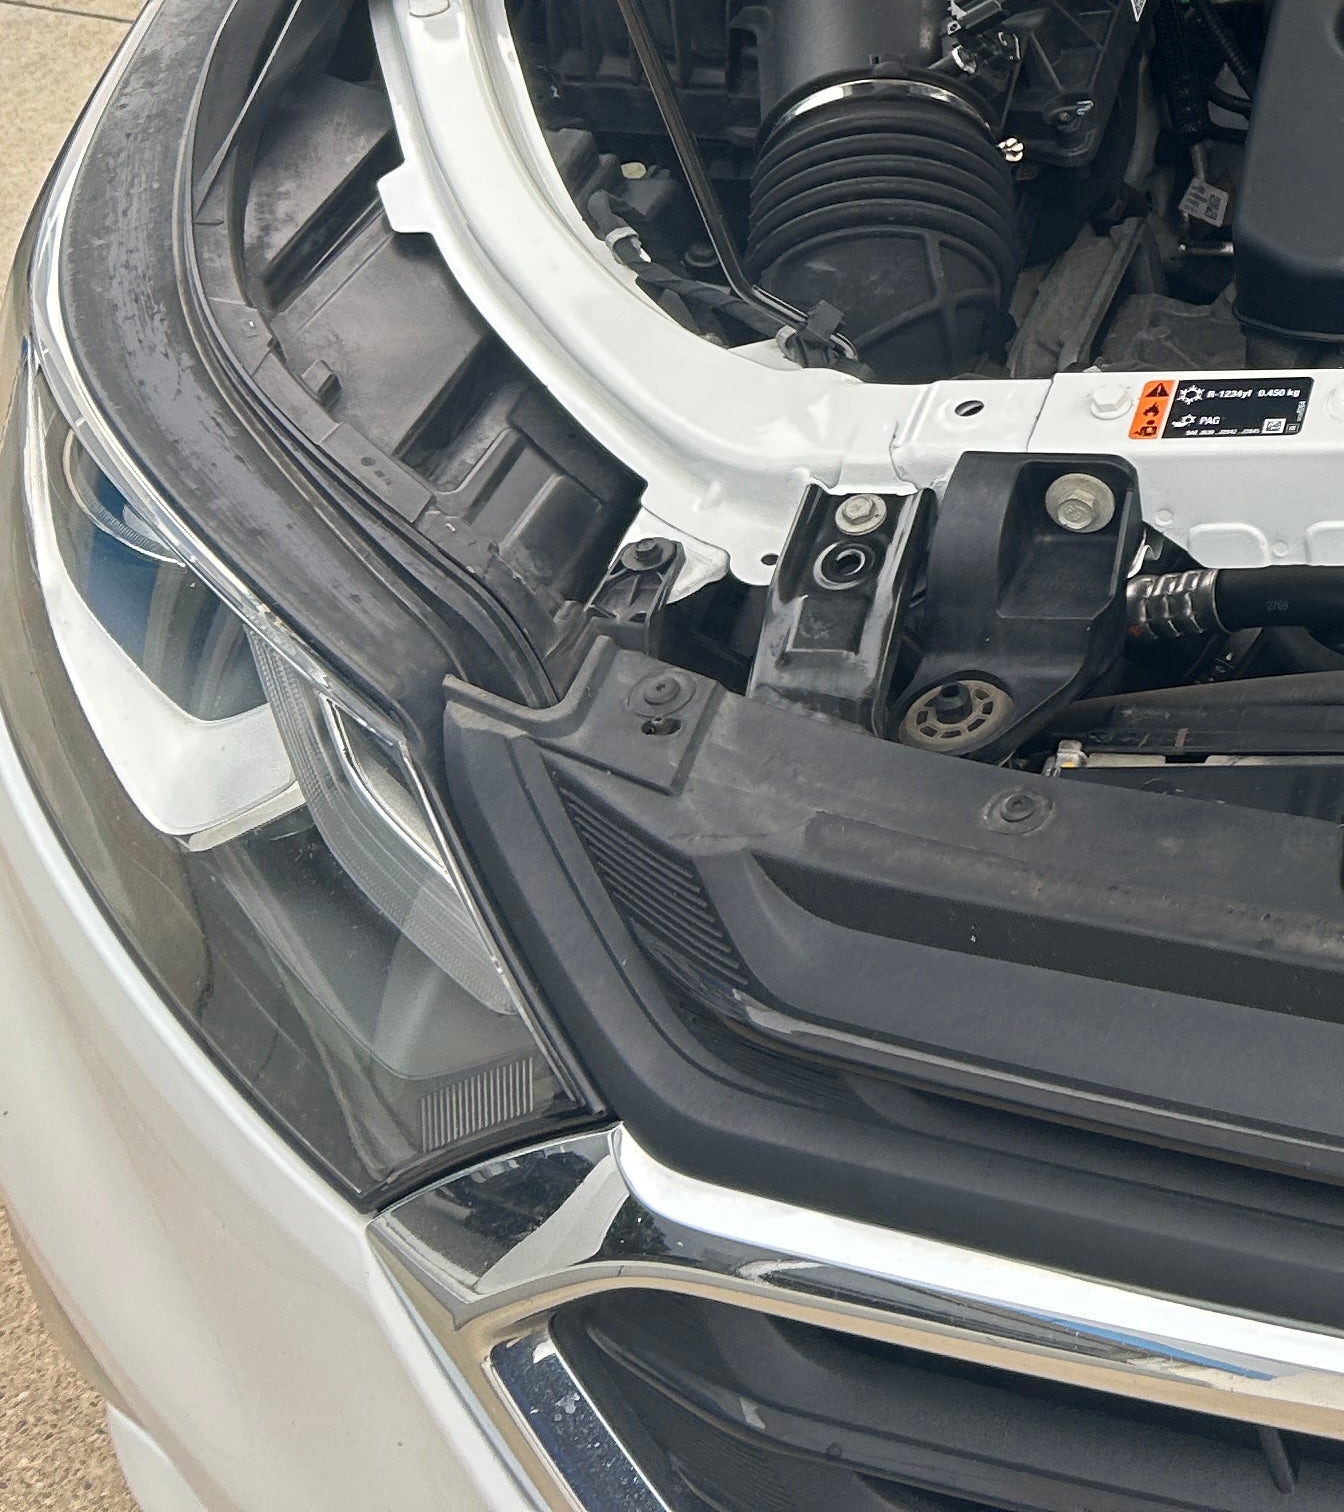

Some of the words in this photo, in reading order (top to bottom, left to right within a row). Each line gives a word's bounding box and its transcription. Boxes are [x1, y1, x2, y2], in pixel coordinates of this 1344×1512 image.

[1206, 389, 1253, 399] R-1234yf
[1287, 388, 1301, 398] kg
[1199, 416, 1221, 425] PAG
